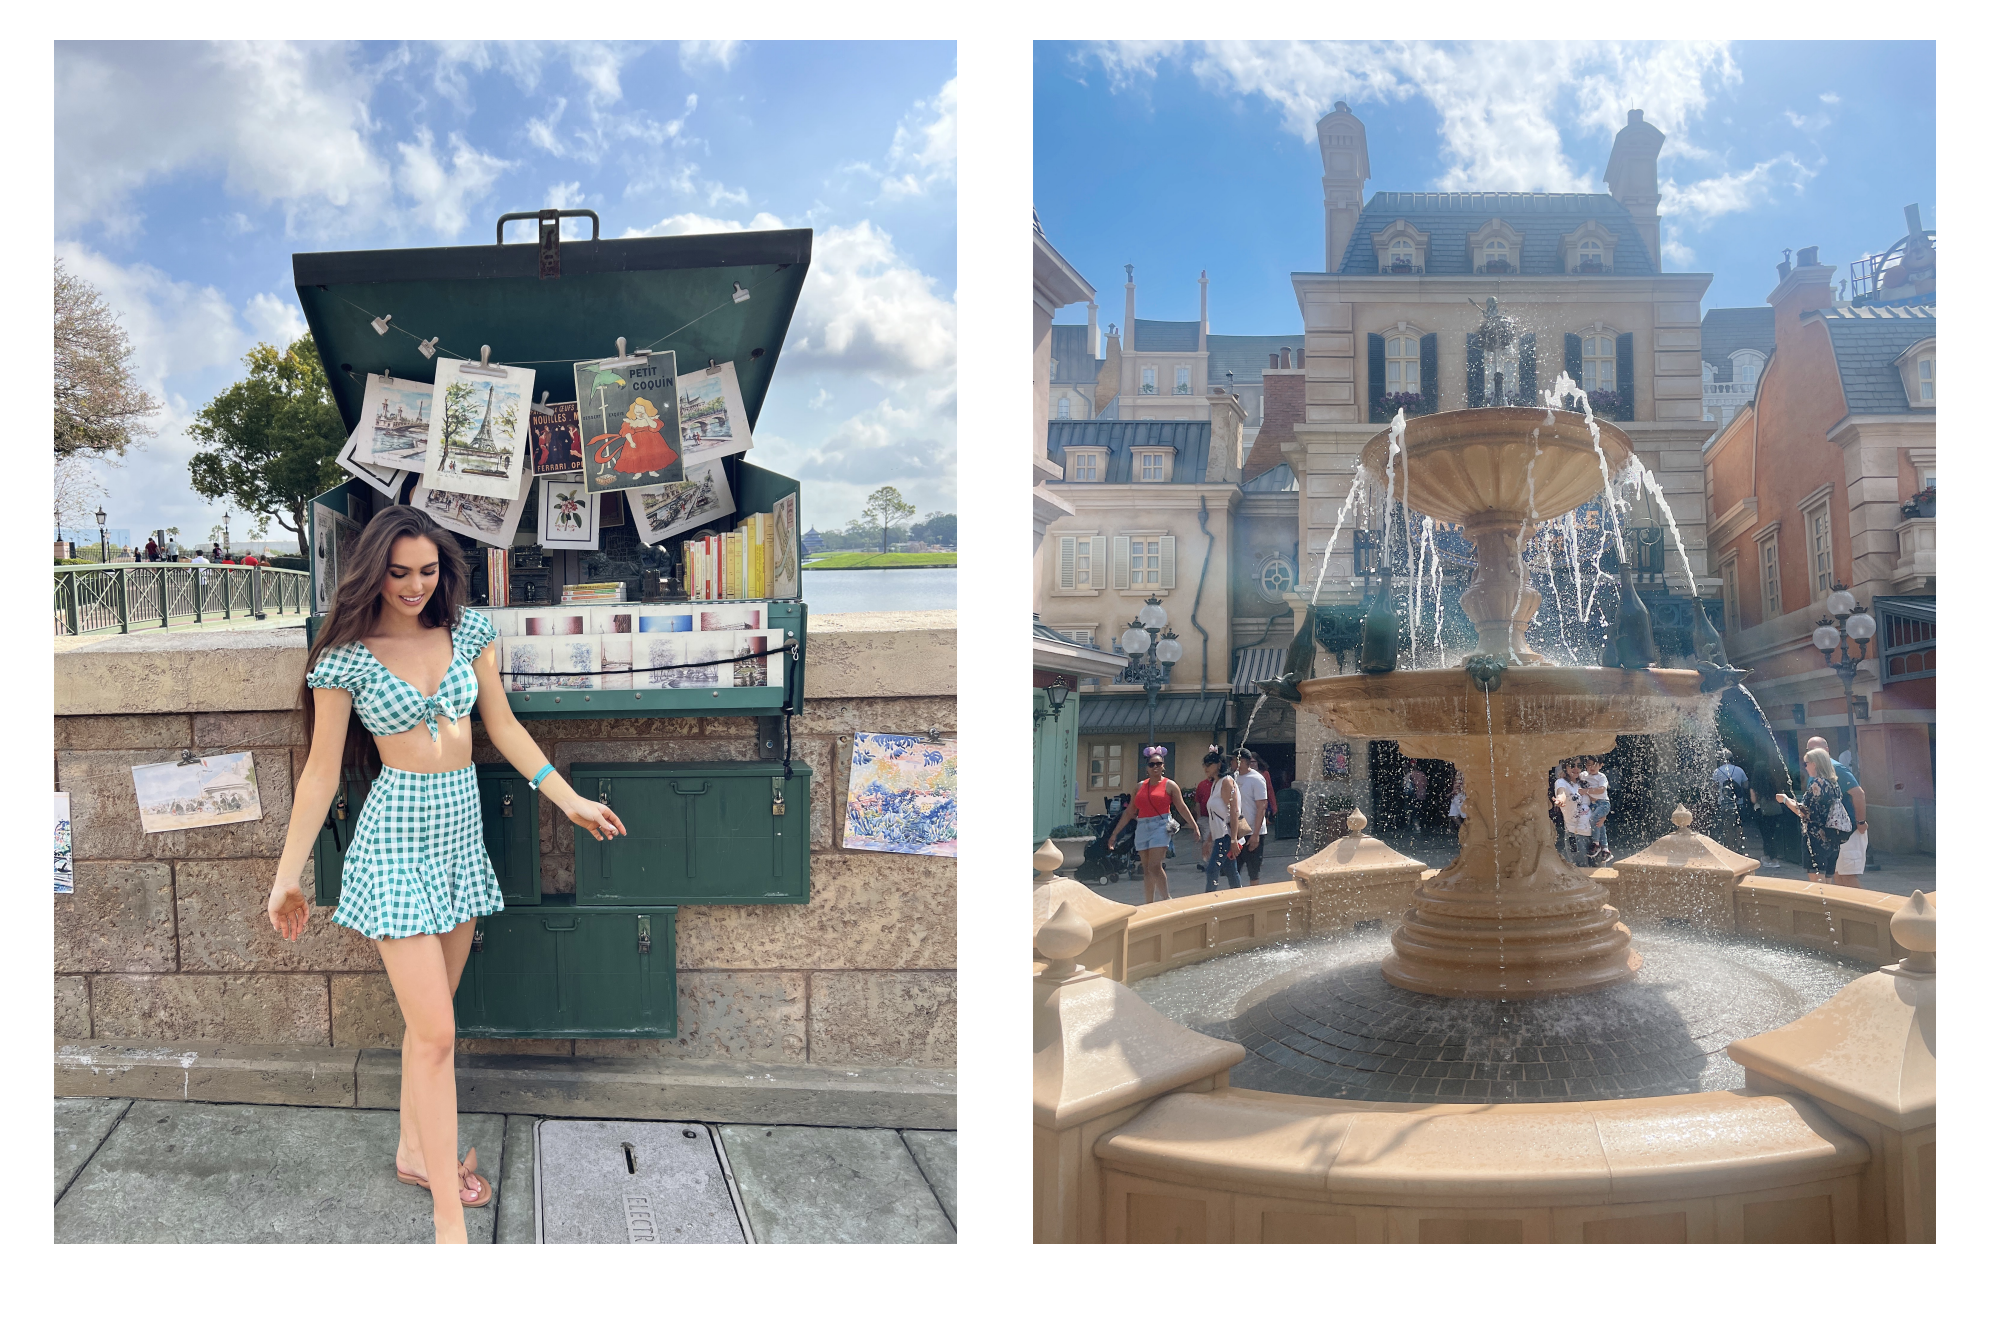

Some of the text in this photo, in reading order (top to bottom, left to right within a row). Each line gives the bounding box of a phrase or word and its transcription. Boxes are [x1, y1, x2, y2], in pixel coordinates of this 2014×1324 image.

[629, 365, 657, 378] PETIT
[632, 376, 674, 391] COQUIN
[533, 413, 567, 425] NOUILLES
[537, 463, 567, 472] FERRARI
[626, 1197, 655, 1242] ELECTR
